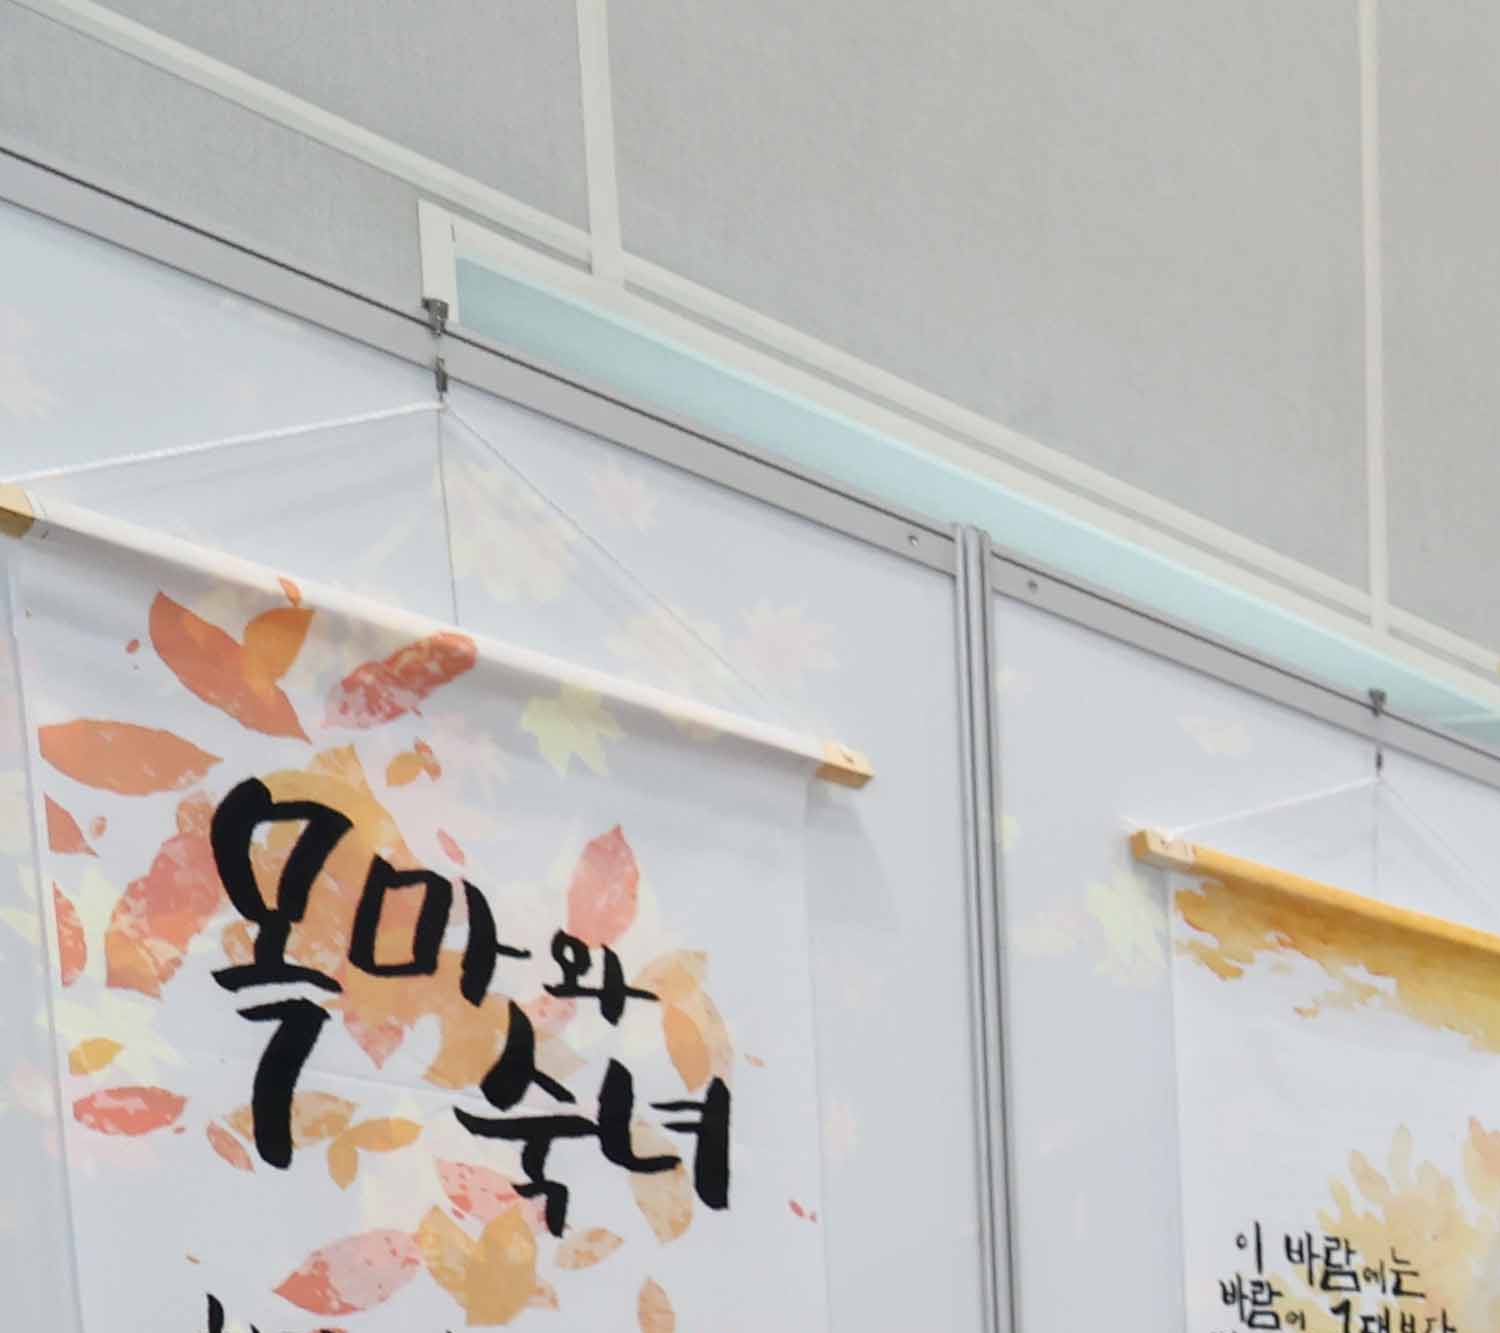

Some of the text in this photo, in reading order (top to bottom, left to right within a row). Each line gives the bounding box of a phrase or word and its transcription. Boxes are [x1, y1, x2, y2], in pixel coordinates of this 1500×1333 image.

[211, 777, 660, 1168] 목마와
[456, 1002, 731, 1237] 숙녀
[1220, 1275, 1305, 1329] 바람이
[1235, 1221, 1425, 1298] 이 바람에는
